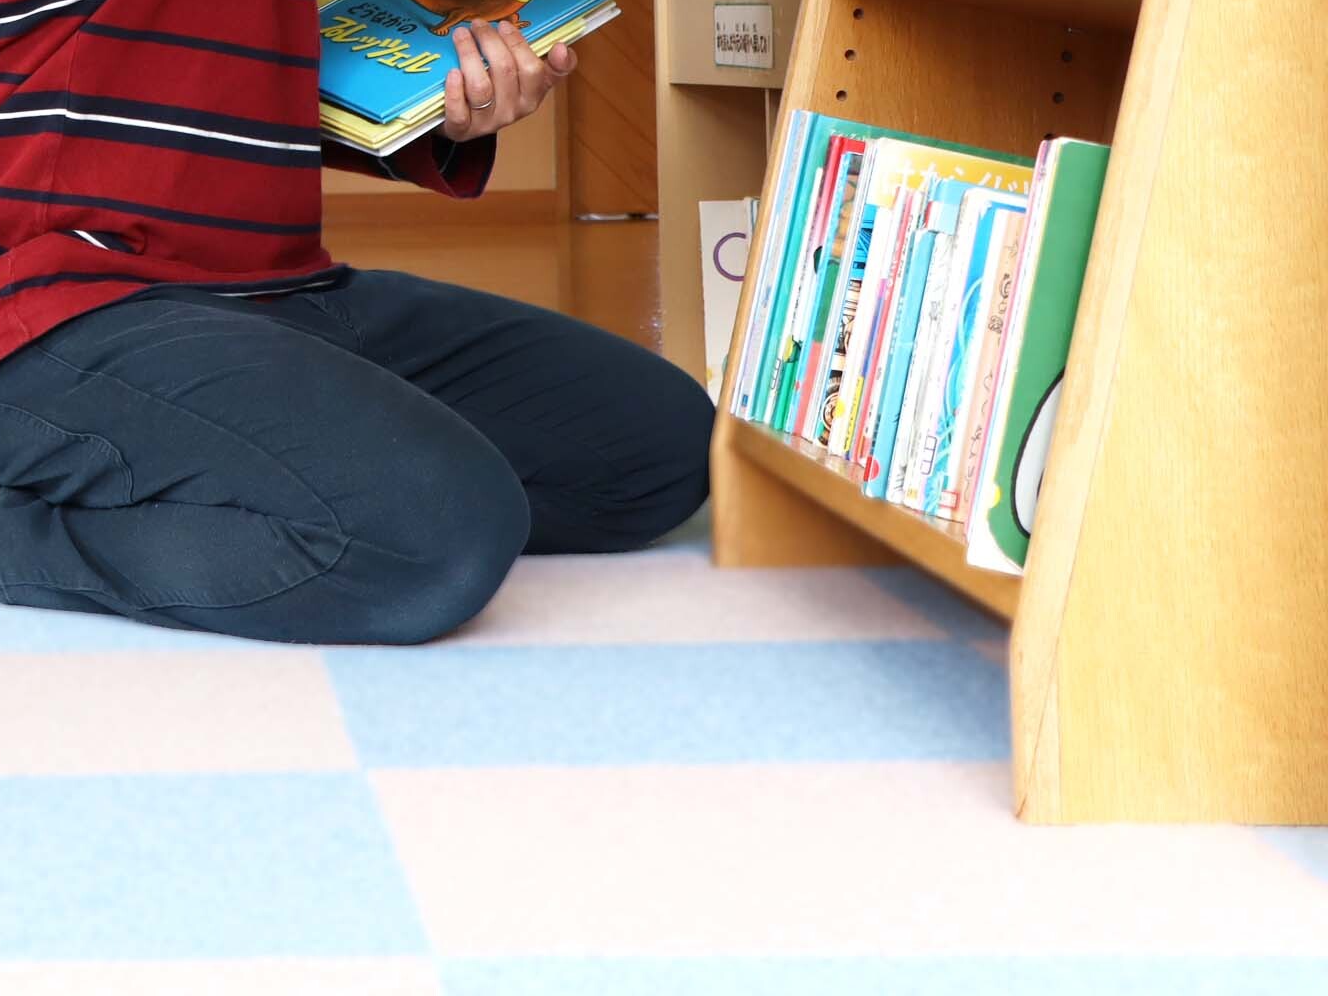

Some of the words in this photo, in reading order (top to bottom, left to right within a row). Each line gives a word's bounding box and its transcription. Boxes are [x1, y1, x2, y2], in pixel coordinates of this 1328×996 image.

[320, 15, 442, 74] プレッツェル
